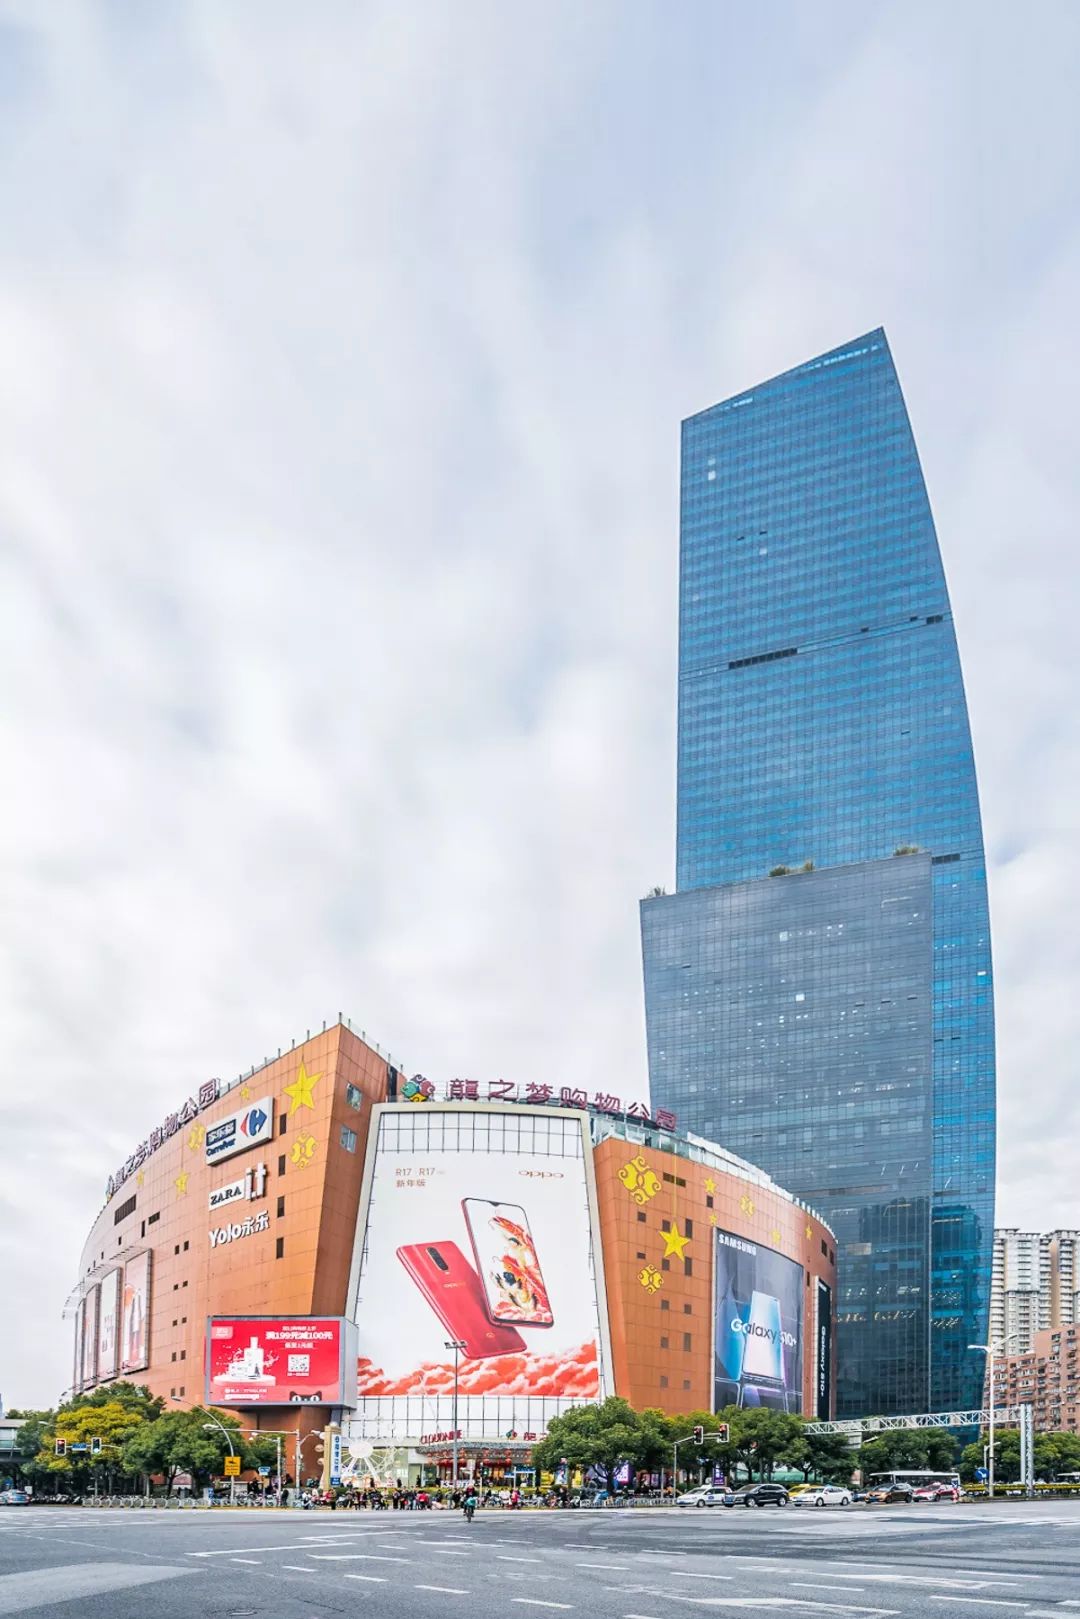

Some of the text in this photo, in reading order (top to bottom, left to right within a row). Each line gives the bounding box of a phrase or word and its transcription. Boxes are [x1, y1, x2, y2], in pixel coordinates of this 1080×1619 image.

[449, 1078, 678, 1132] 龍之梦购物公园
[395, 1168, 412, 1177] R17
[419, 1167, 436, 1176] R17
[210, 1186, 242, 1206] ZARA
[718, 1233, 757, 1257] SAMSUNG
[730, 1318, 777, 1345] Galaxy
[819, 1325, 827, 1371] Galaxy
